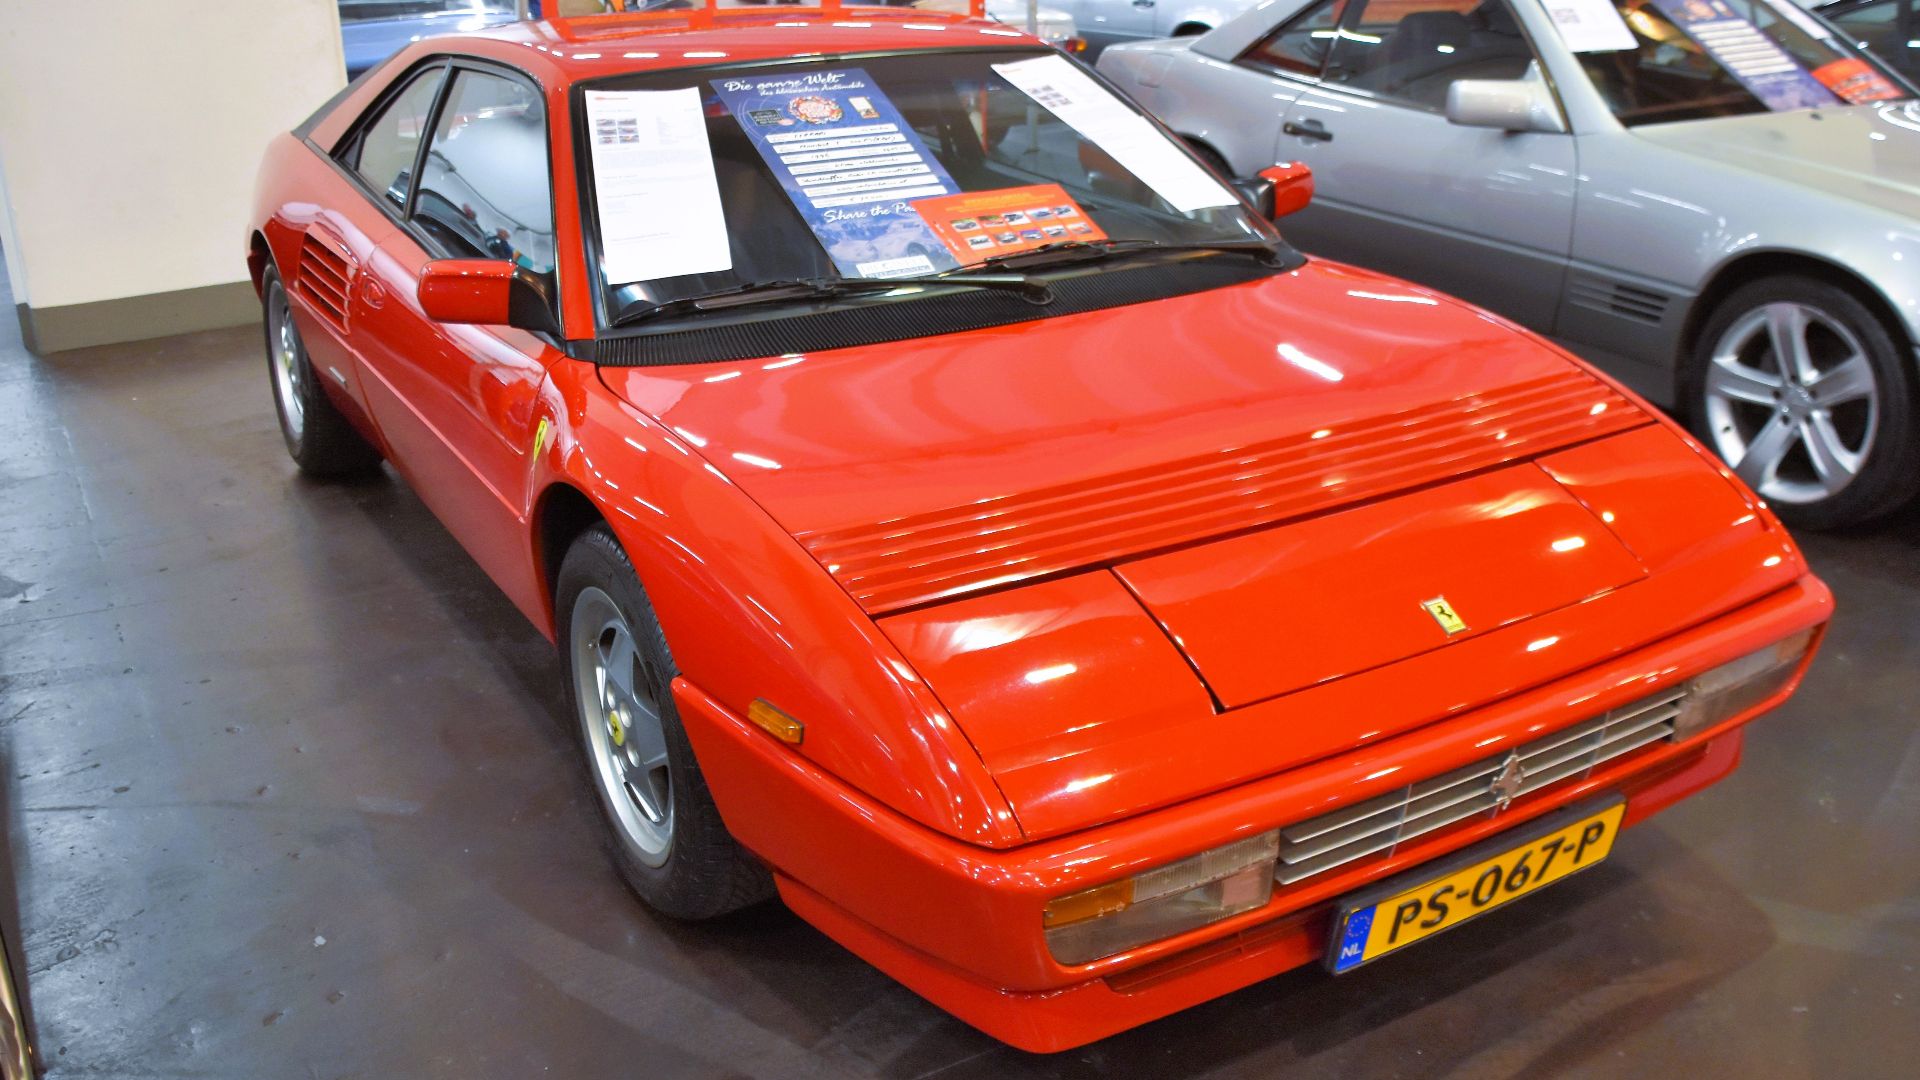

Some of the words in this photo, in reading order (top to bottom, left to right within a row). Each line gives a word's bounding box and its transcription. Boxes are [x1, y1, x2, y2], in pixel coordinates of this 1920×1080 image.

[724, 80, 753, 92] Die
[757, 79, 802, 92] ganze
[803, 73, 845, 85] Welt
[823, 209, 868, 223] Share
[869, 205, 892, 217] the
[1388, 820, 1605, 944] PS-067-P
[1341, 942, 1362, 960] NL
